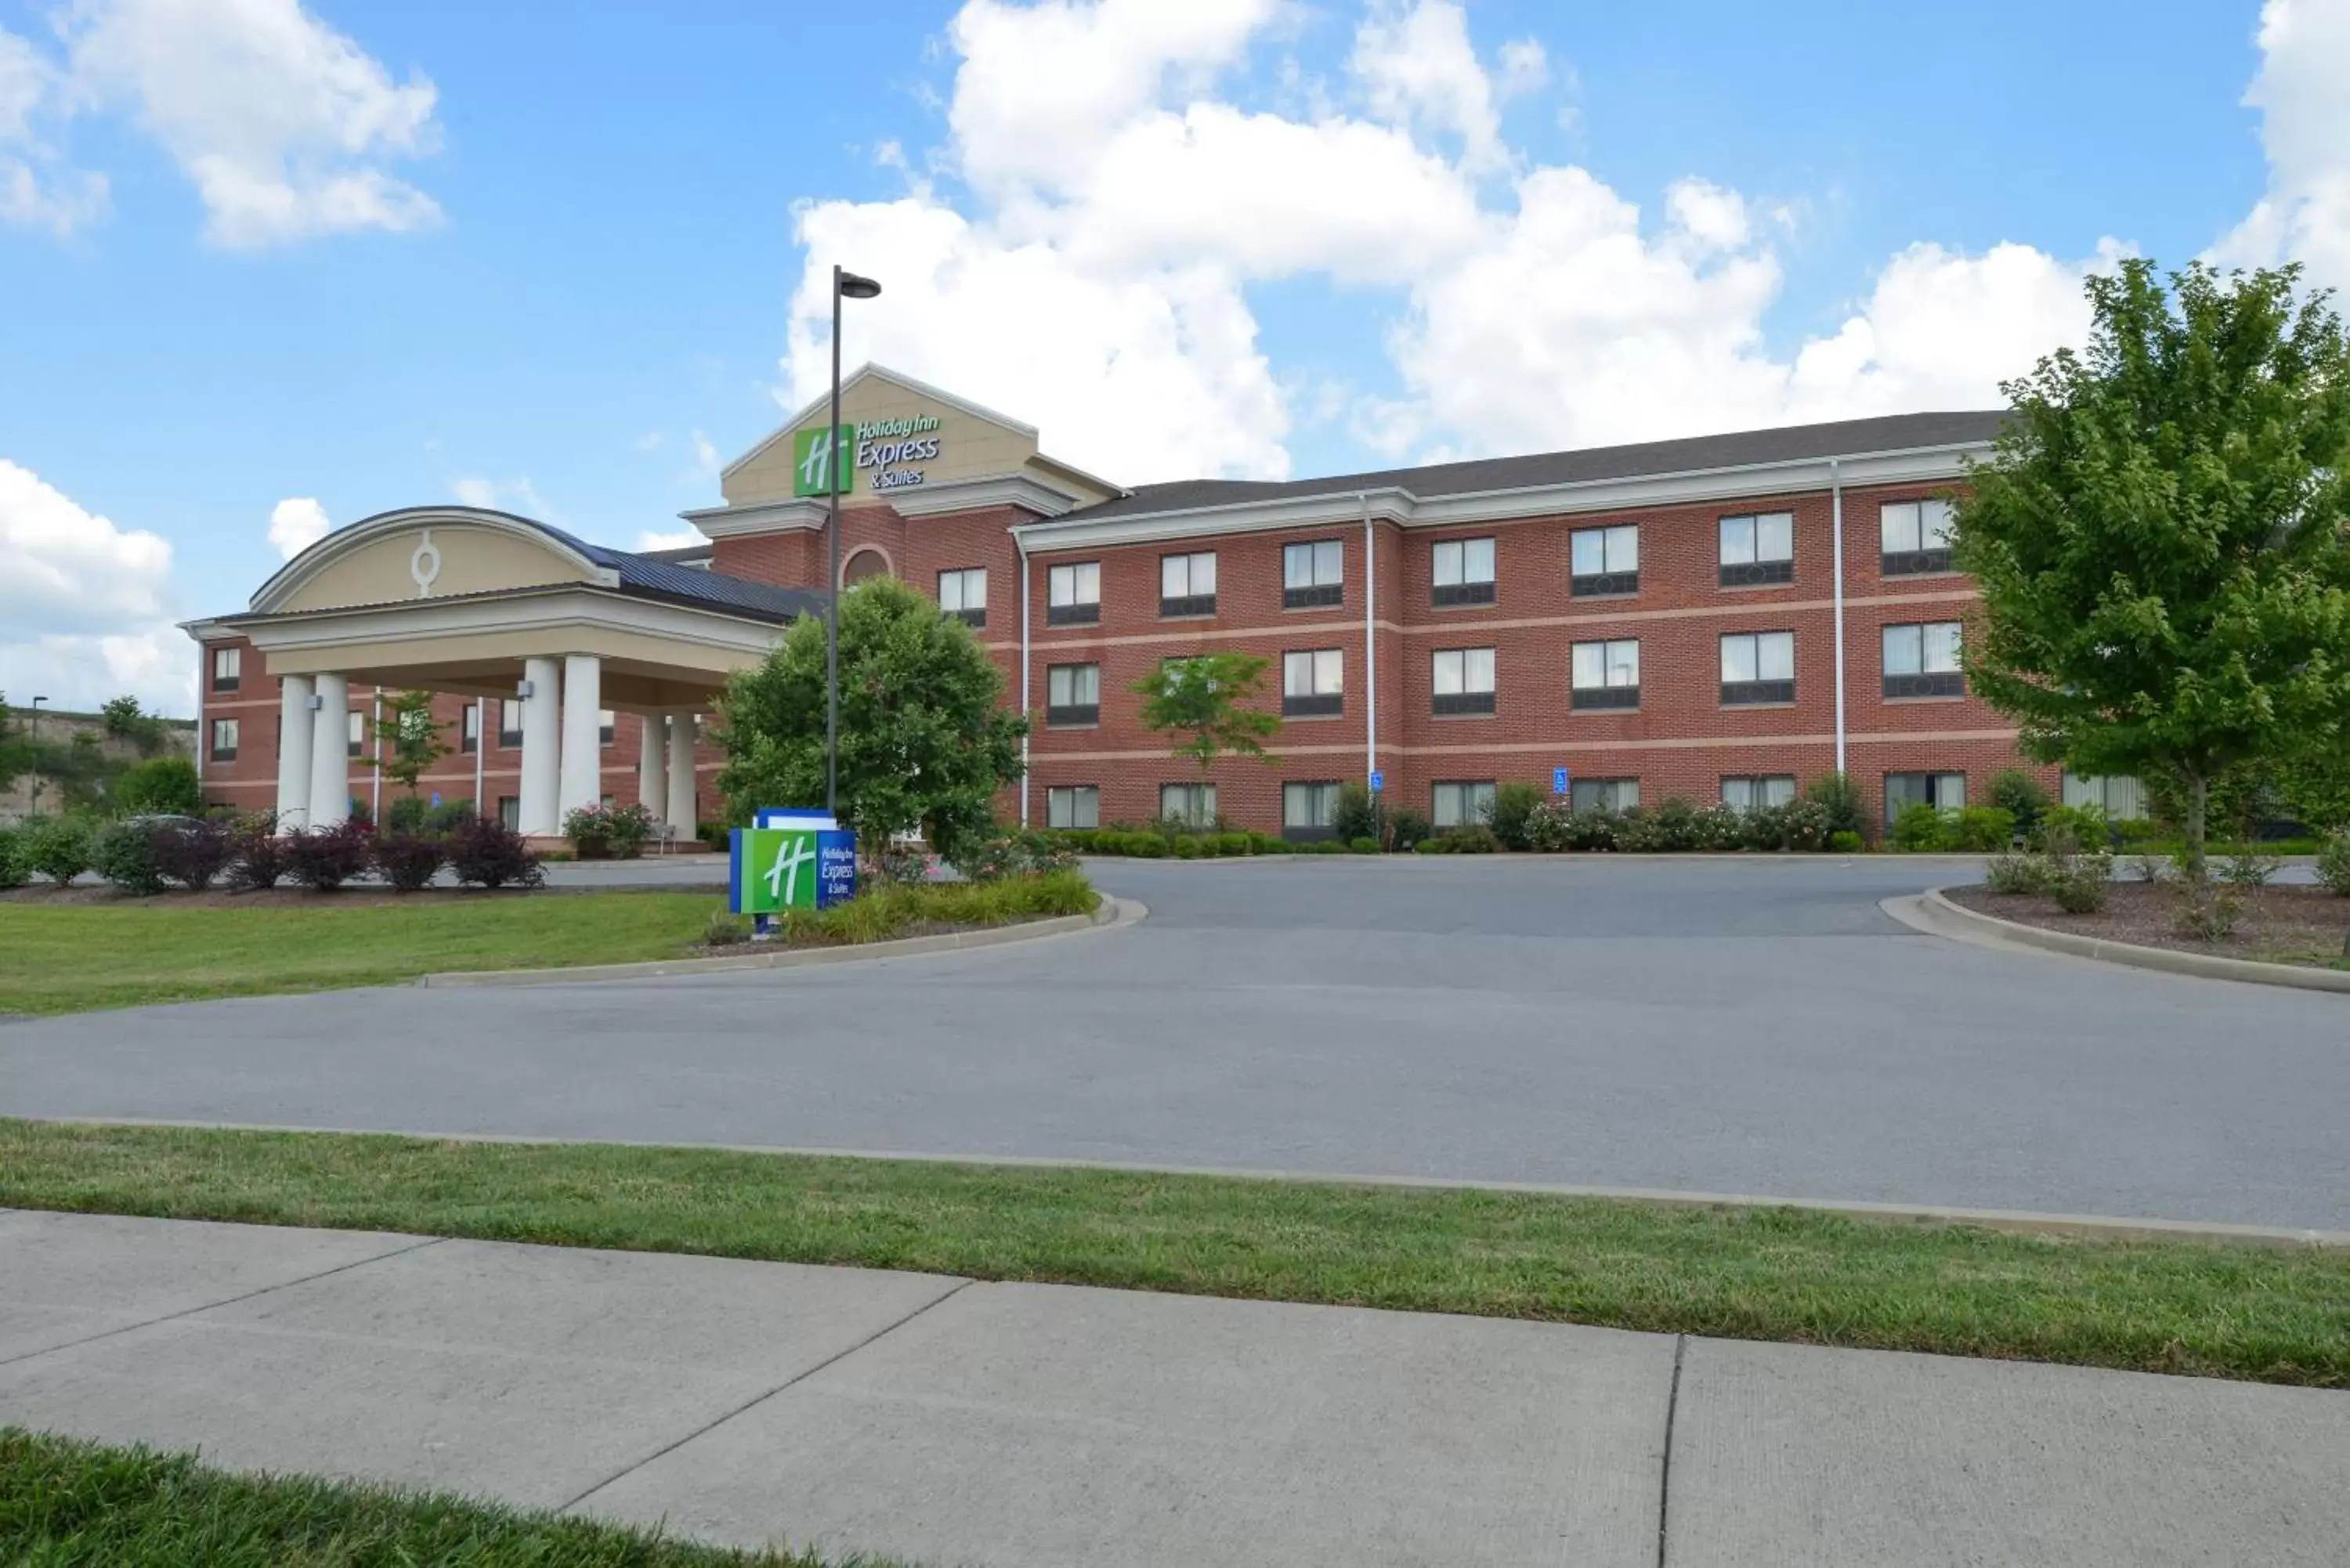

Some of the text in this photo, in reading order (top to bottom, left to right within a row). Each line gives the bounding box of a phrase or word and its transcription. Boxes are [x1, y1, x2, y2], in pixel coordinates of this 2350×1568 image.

[857, 414, 939, 439] Holiday Inn
[855, 439, 940, 470] Express
[871, 470, 924, 489] & Suites
[822, 862, 853, 882] Express
